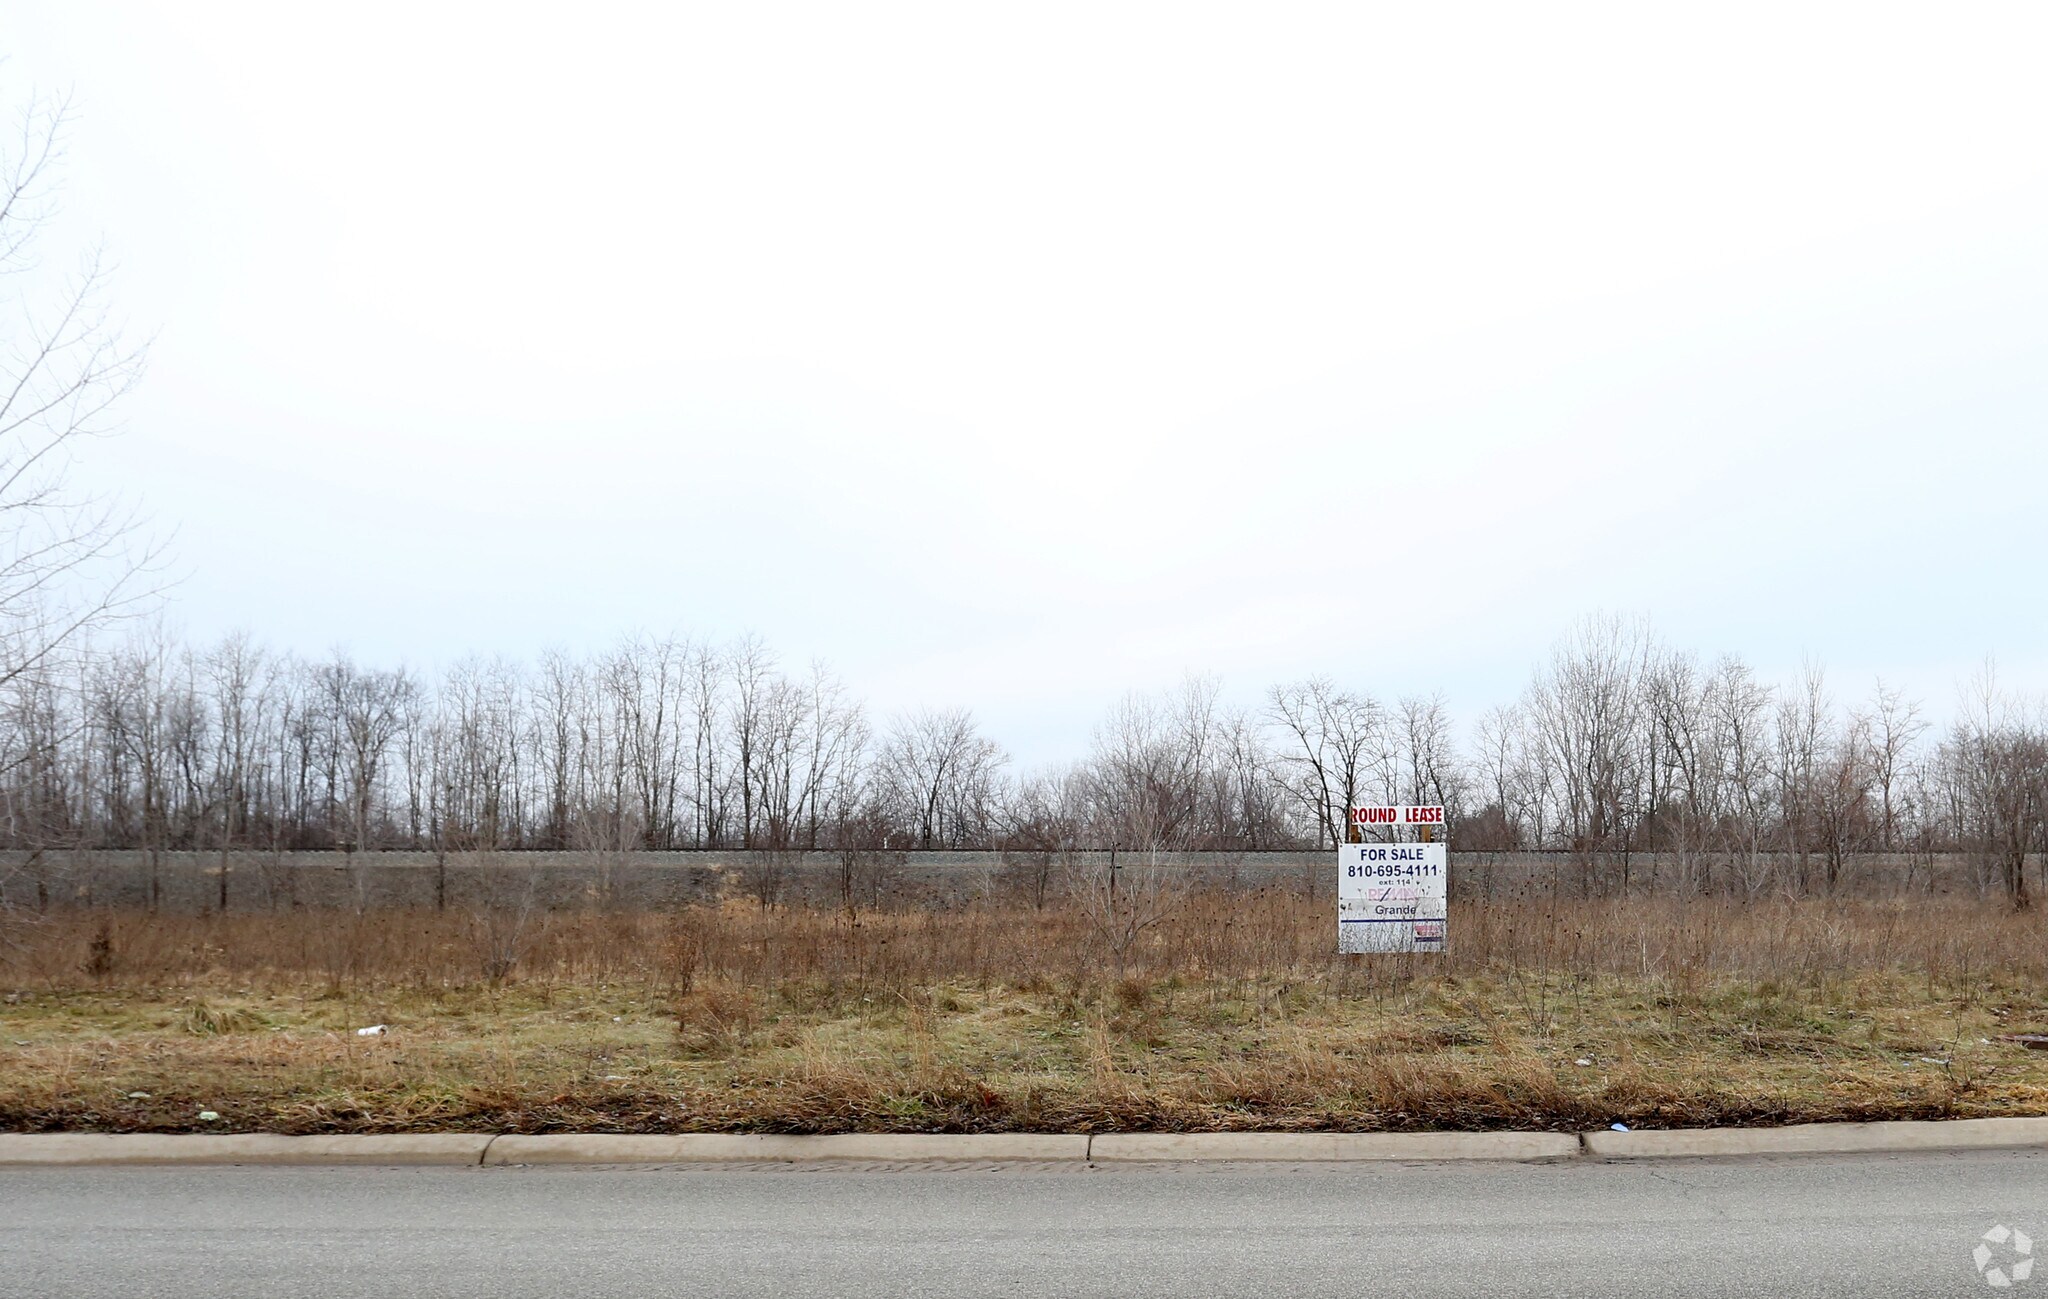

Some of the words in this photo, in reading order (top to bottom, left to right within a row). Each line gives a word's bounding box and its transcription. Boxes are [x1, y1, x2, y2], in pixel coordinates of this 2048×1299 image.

[1405, 807, 1442, 823] LEASE
[1361, 849, 1387, 860] FOR
[1391, 849, 1424, 860] SALE
[1348, 865, 1437, 877] 810-695-4111
[1375, 905, 1417, 915] Grande
